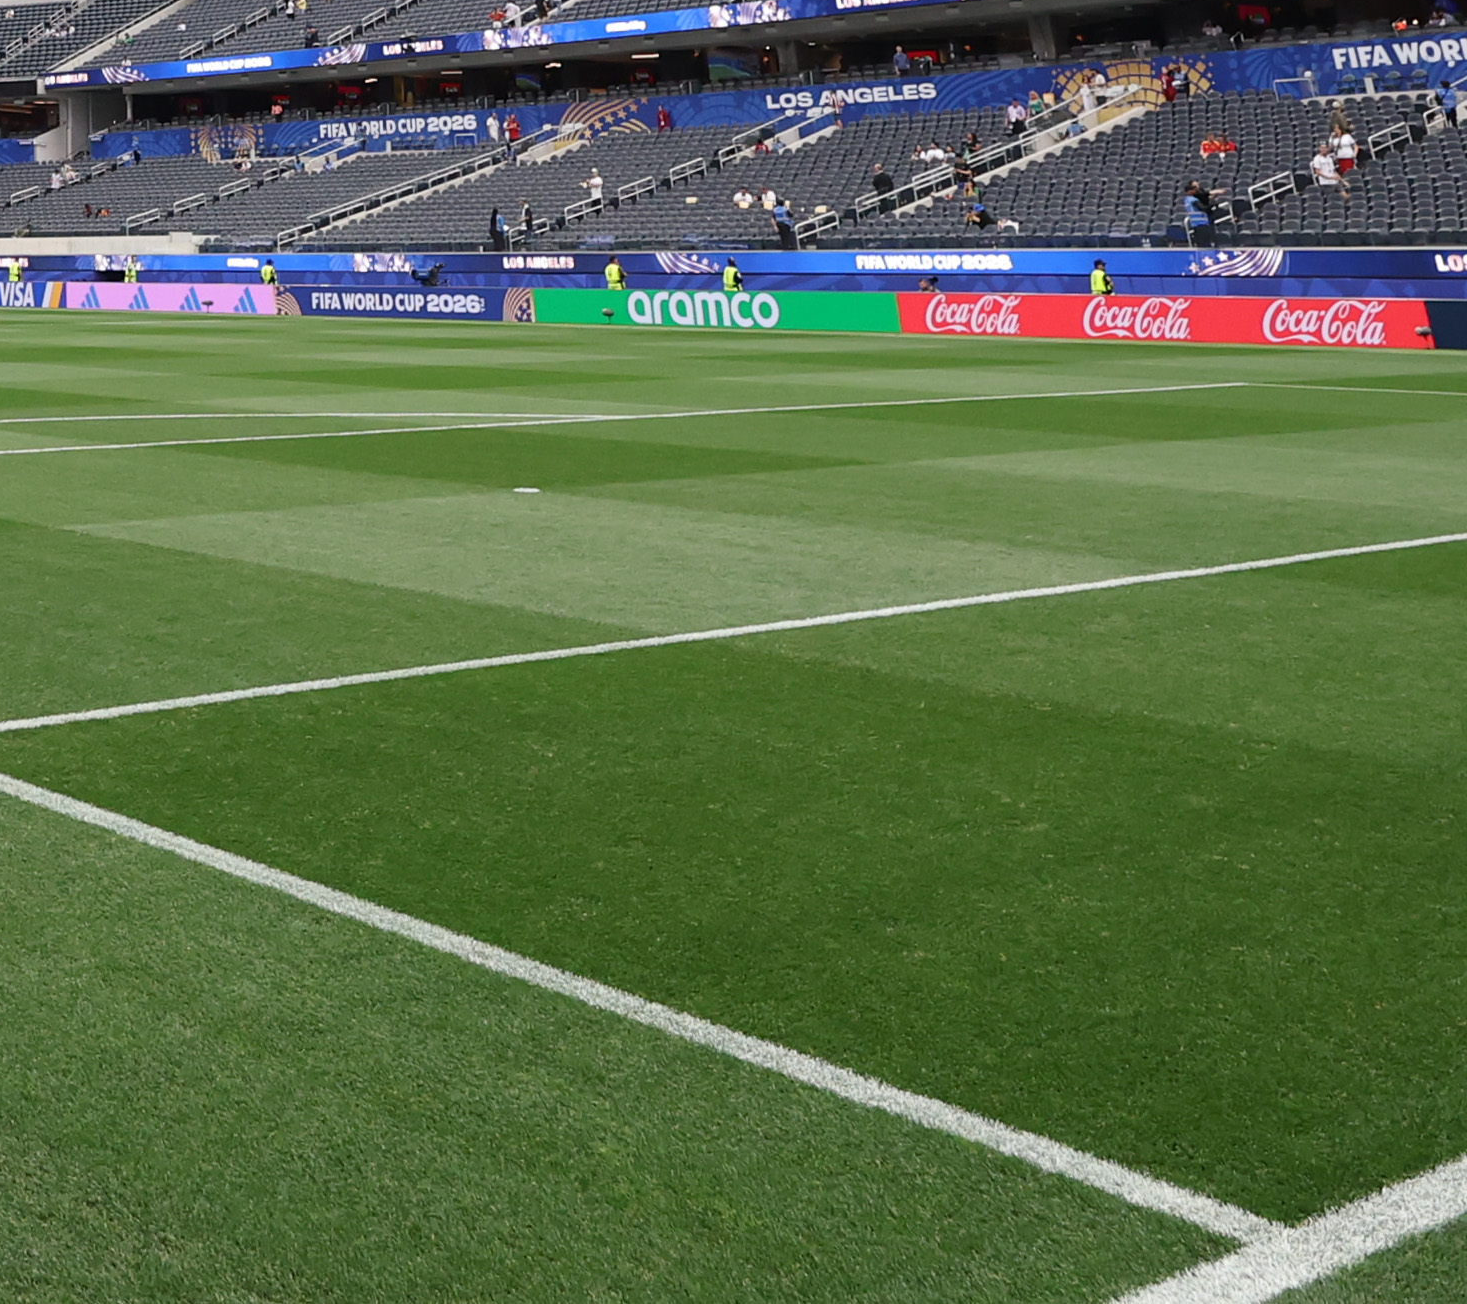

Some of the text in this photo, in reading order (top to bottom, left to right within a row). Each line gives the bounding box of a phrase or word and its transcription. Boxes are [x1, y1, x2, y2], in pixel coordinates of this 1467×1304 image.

[1331, 44, 1393, 70] FIFA
[765, 83, 937, 110] LOS ANGELES
[319, 122, 348, 139] FIFA
[397, 117, 426, 134] CUP
[426, 114, 478, 133] 2026
[525, 256, 575, 270] ANGELES
[855, 254, 887, 270] FIFA
[883, 254, 935, 270] WORLD
[932, 254, 963, 271] CUP
[311, 292, 482, 313] FIFA WORLD CUP 2026
[627, 291, 781, 329] aramco
[925, 293, 1022, 336] Coca-Cola
[1082, 296, 1192, 340] Coca-Cola
[1261, 300, 1387, 345] Coca-Cola
